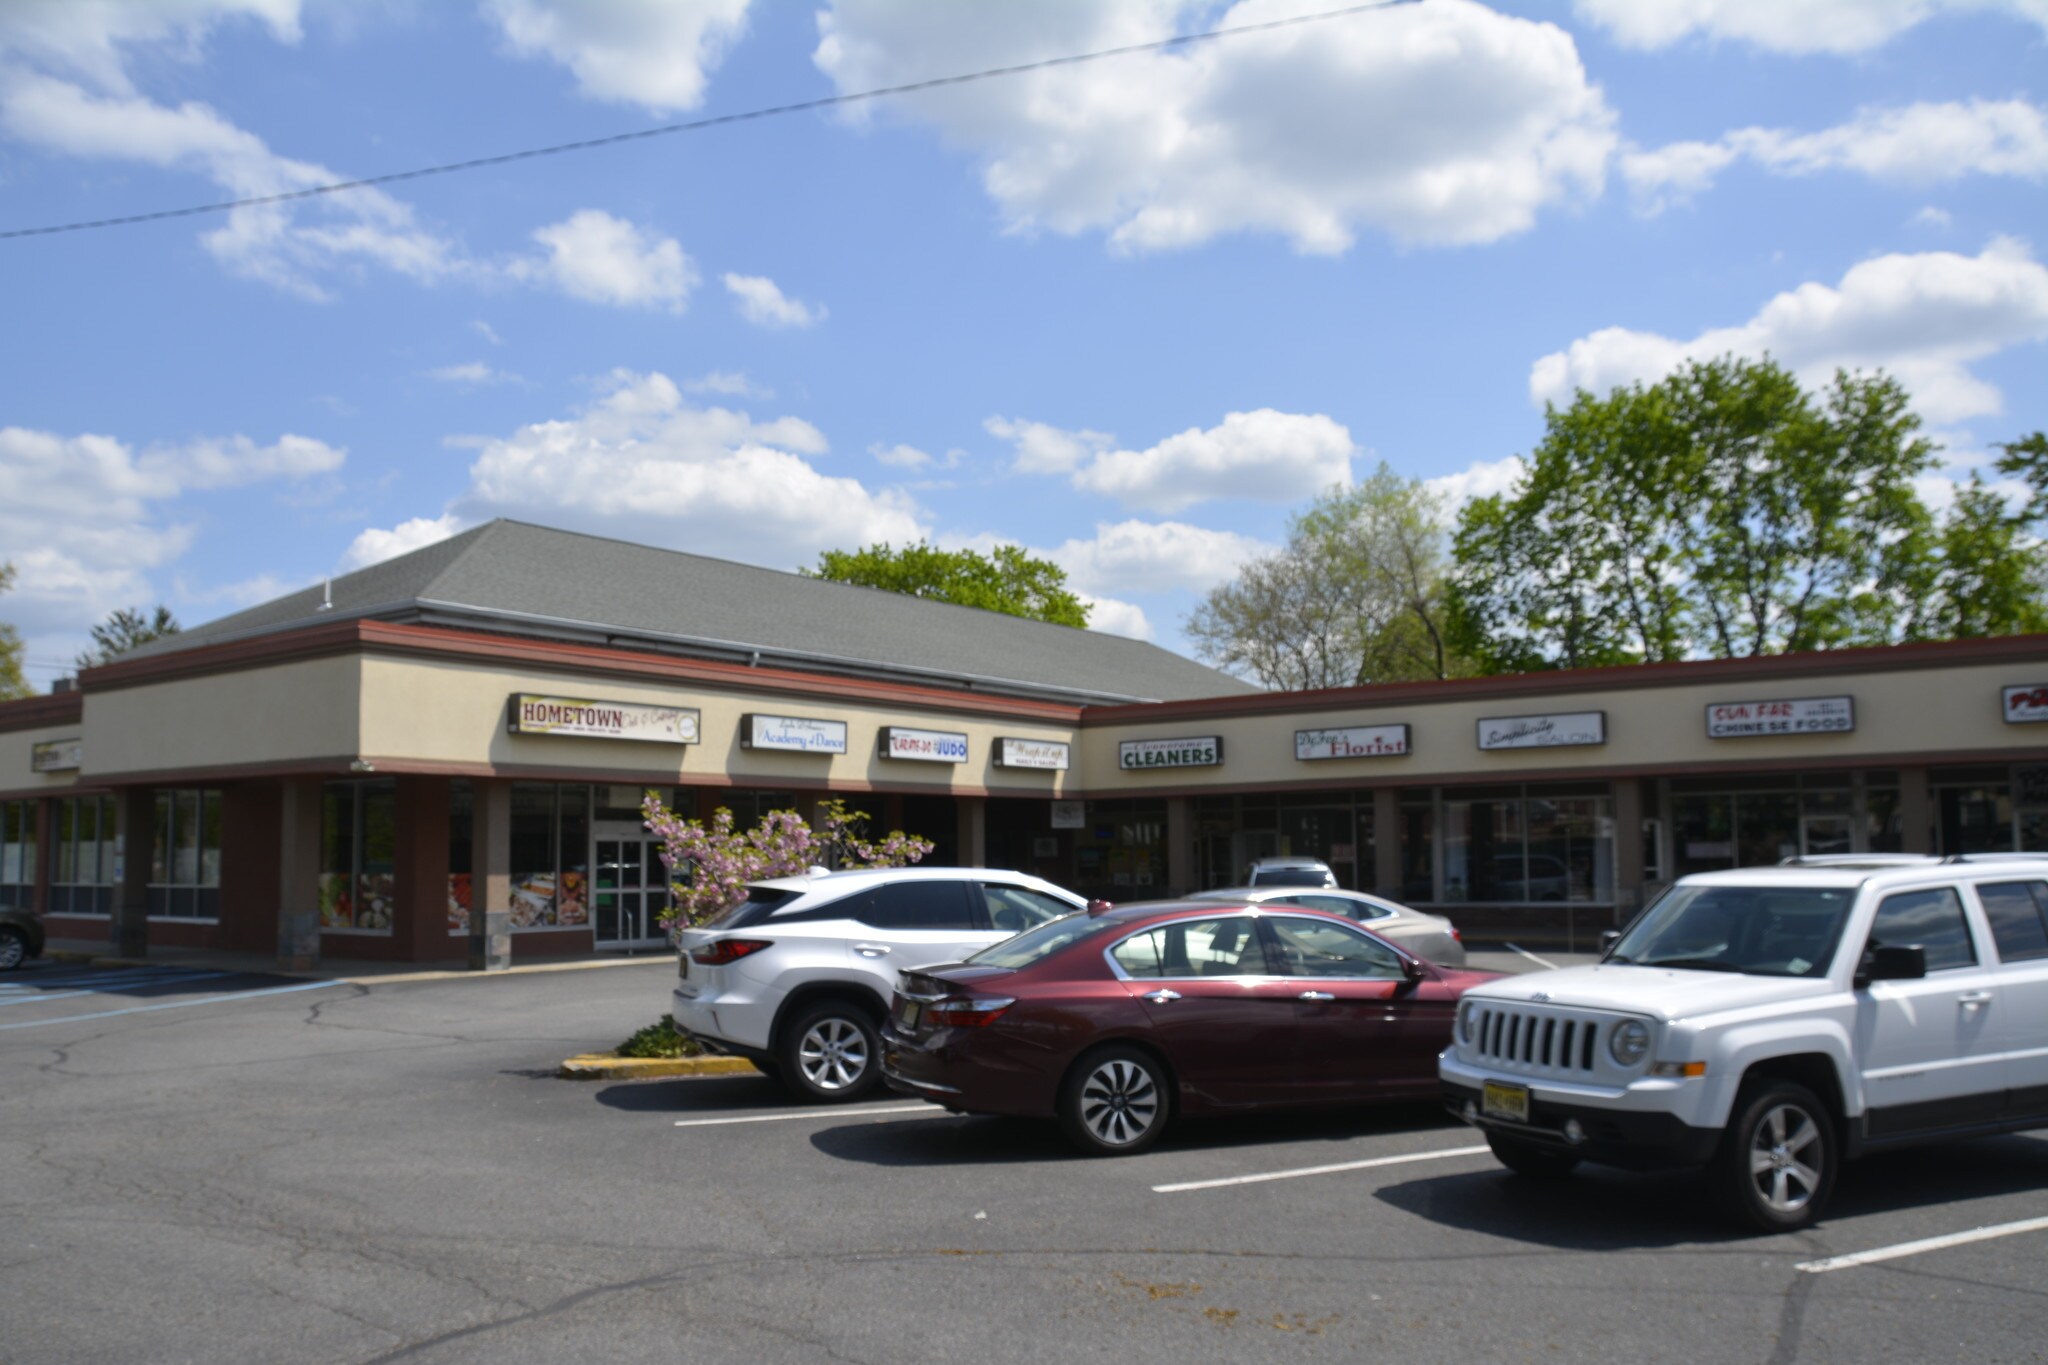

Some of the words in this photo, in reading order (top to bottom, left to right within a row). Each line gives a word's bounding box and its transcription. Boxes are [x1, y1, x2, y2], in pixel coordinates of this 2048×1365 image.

[523, 702, 623, 729] HOMETOWN
[1715, 706, 1751, 720] SUN
[1486, 718, 1554, 745] Simplicity
[1714, 721, 1790, 733] CHINESE
[1796, 717, 1846, 728] FOOD
[763, 727, 807, 750] Academy
[816, 732, 844, 748] Dance
[1537, 732, 1597, 744] SALON
[937, 742, 966, 756] JUDO
[1331, 740, 1404, 756] Florist
[1124, 748, 1213, 766] CLEANERS
